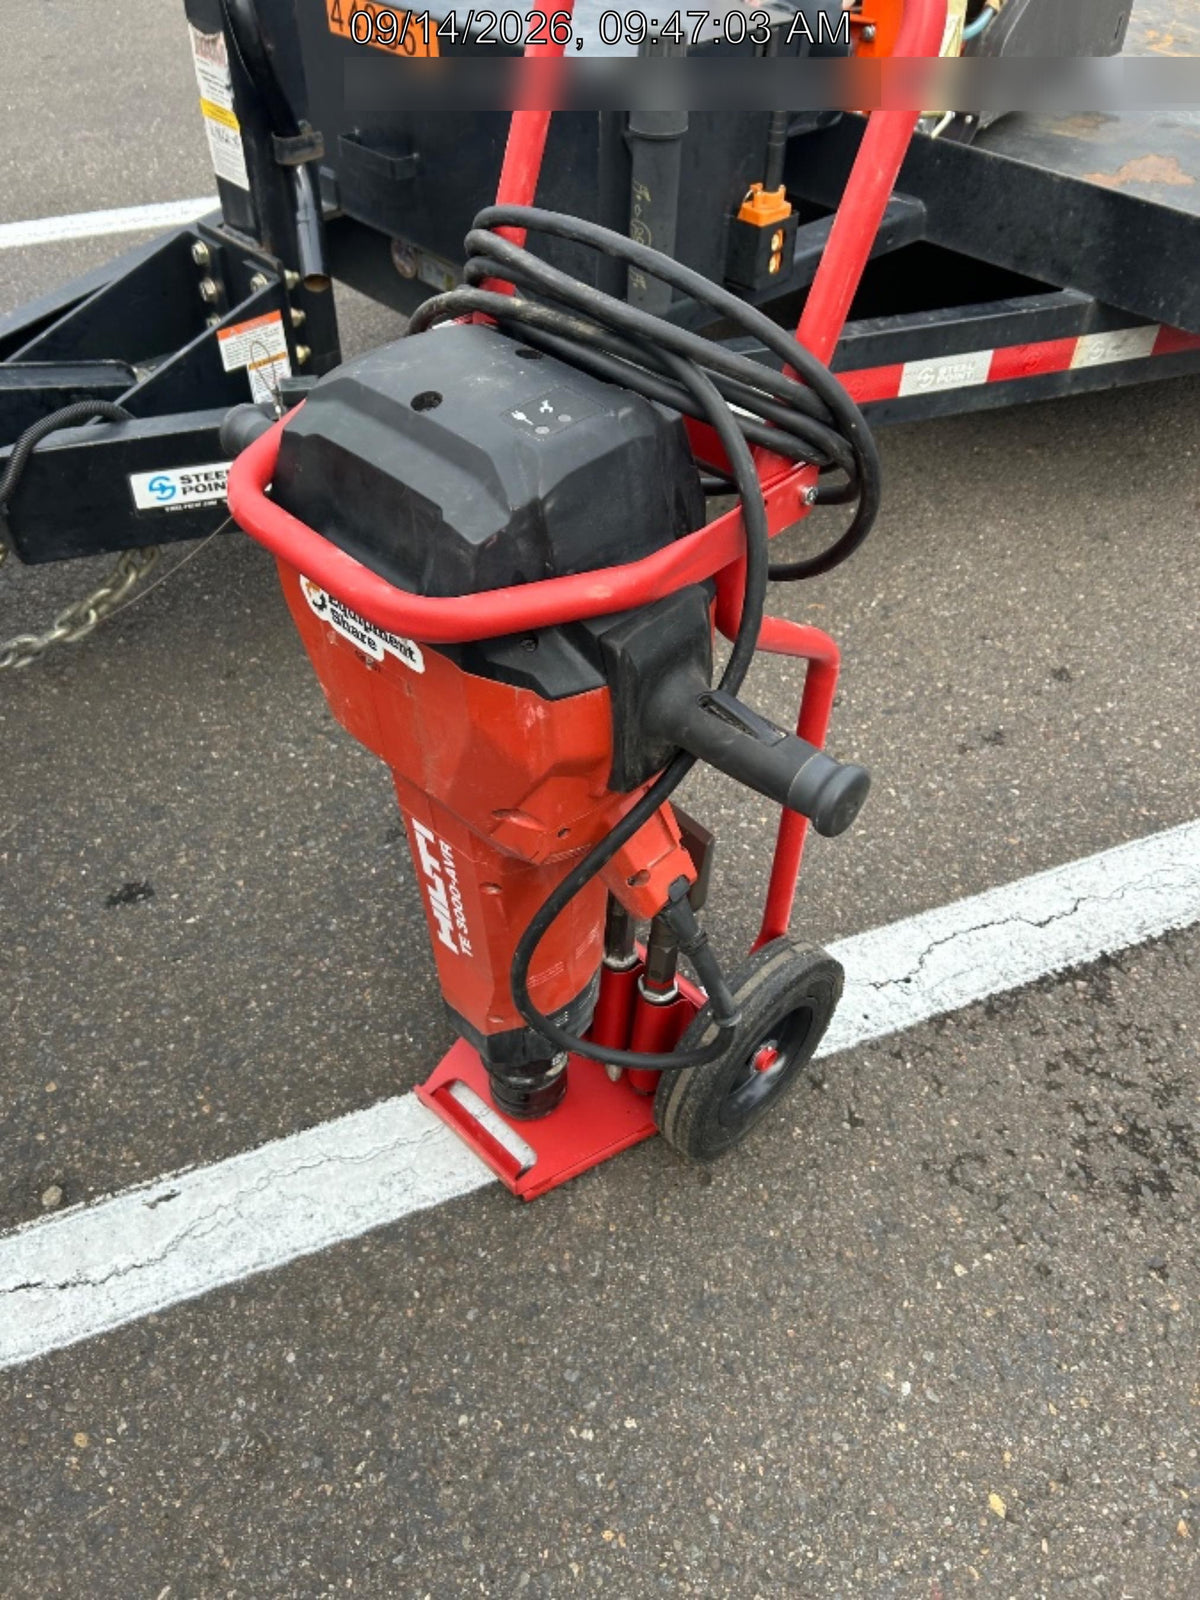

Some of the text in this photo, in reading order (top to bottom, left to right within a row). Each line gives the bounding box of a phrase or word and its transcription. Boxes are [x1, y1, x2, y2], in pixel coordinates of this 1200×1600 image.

[181, 480, 228, 496] POIN
[330, 607, 378, 652] Share
[411, 817, 460, 956] HILTI
[438, 838, 474, 958] TE 3000-AVR
